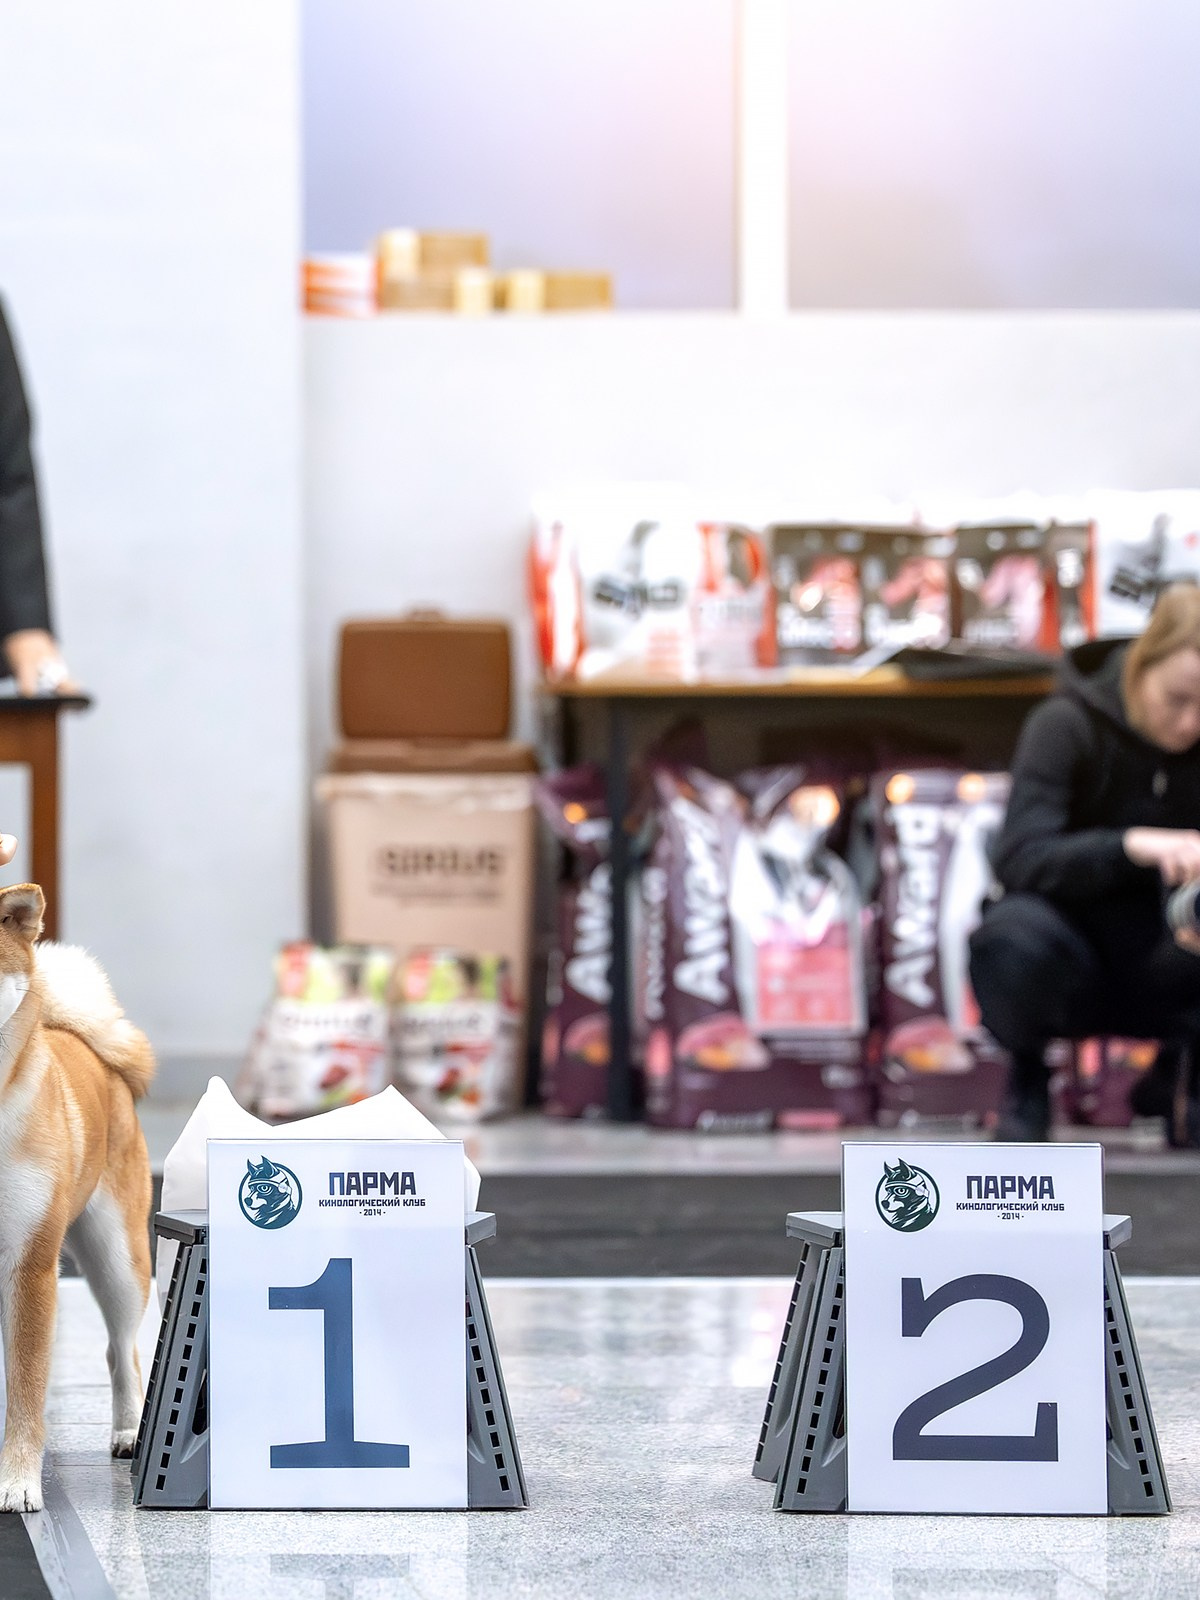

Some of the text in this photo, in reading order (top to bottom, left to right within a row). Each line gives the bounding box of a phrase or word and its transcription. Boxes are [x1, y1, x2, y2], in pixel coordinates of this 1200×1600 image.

[329, 1171, 417, 1196] ПАРМА
[966, 1175, 1055, 1200] ПАРМА
[318, 1197, 426, 1207] КИНОЛОГИЧЕСКИЙ КЛУБ
[956, 1201, 1065, 1212] КИНОЛОГИЧЕСКИЙ КЛУБ
[268, 1257, 411, 1469] 1
[892, 1273, 1059, 1463] 2
